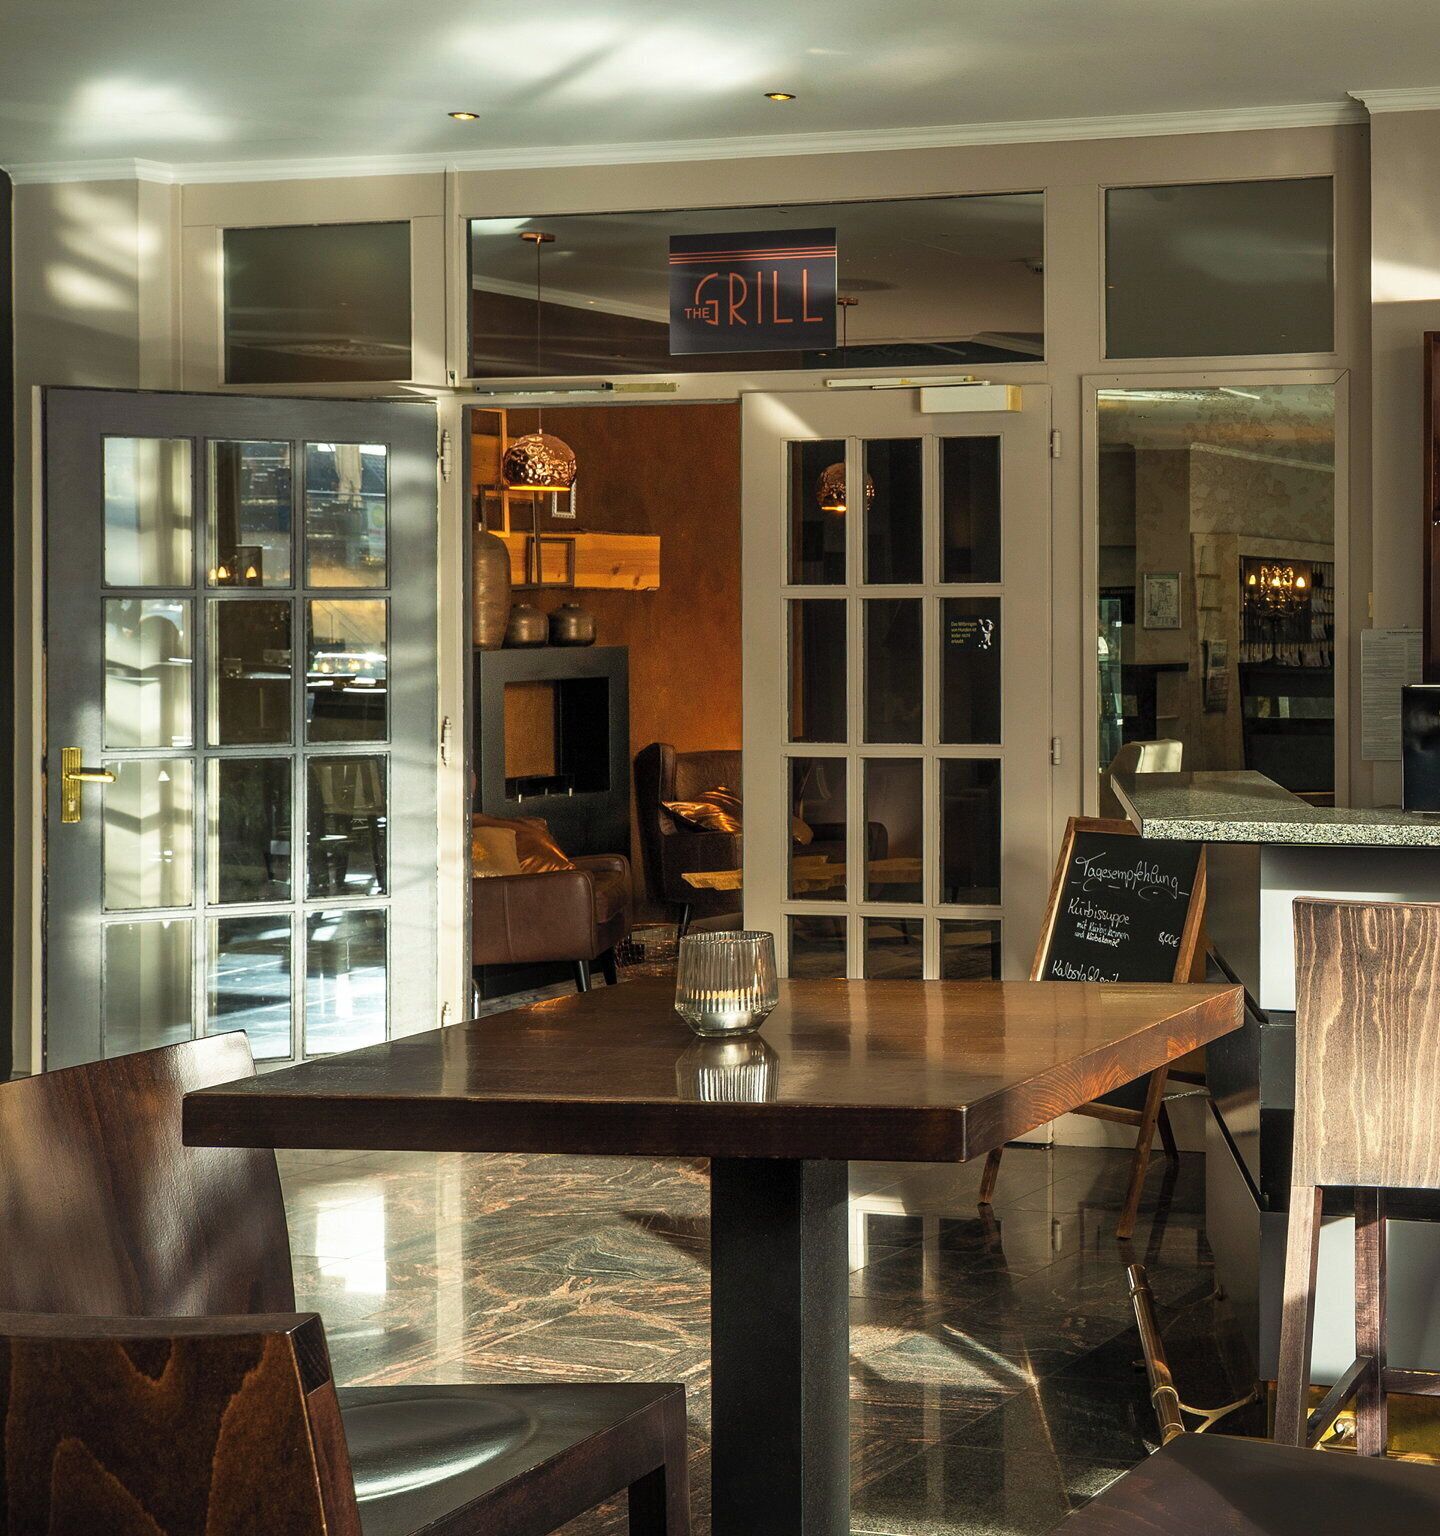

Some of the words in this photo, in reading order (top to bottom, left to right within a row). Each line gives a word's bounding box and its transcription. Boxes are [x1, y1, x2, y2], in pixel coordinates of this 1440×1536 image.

[694, 269, 823, 326] GRILL
[684, 308, 710, 320] THE
[1074, 851, 1179, 900] Tagesempfehlung
[1067, 897, 1131, 928] Kürbissuppe
[1076, 919, 1088, 930] mit
[1157, 931, 1181, 948] 8,00€
